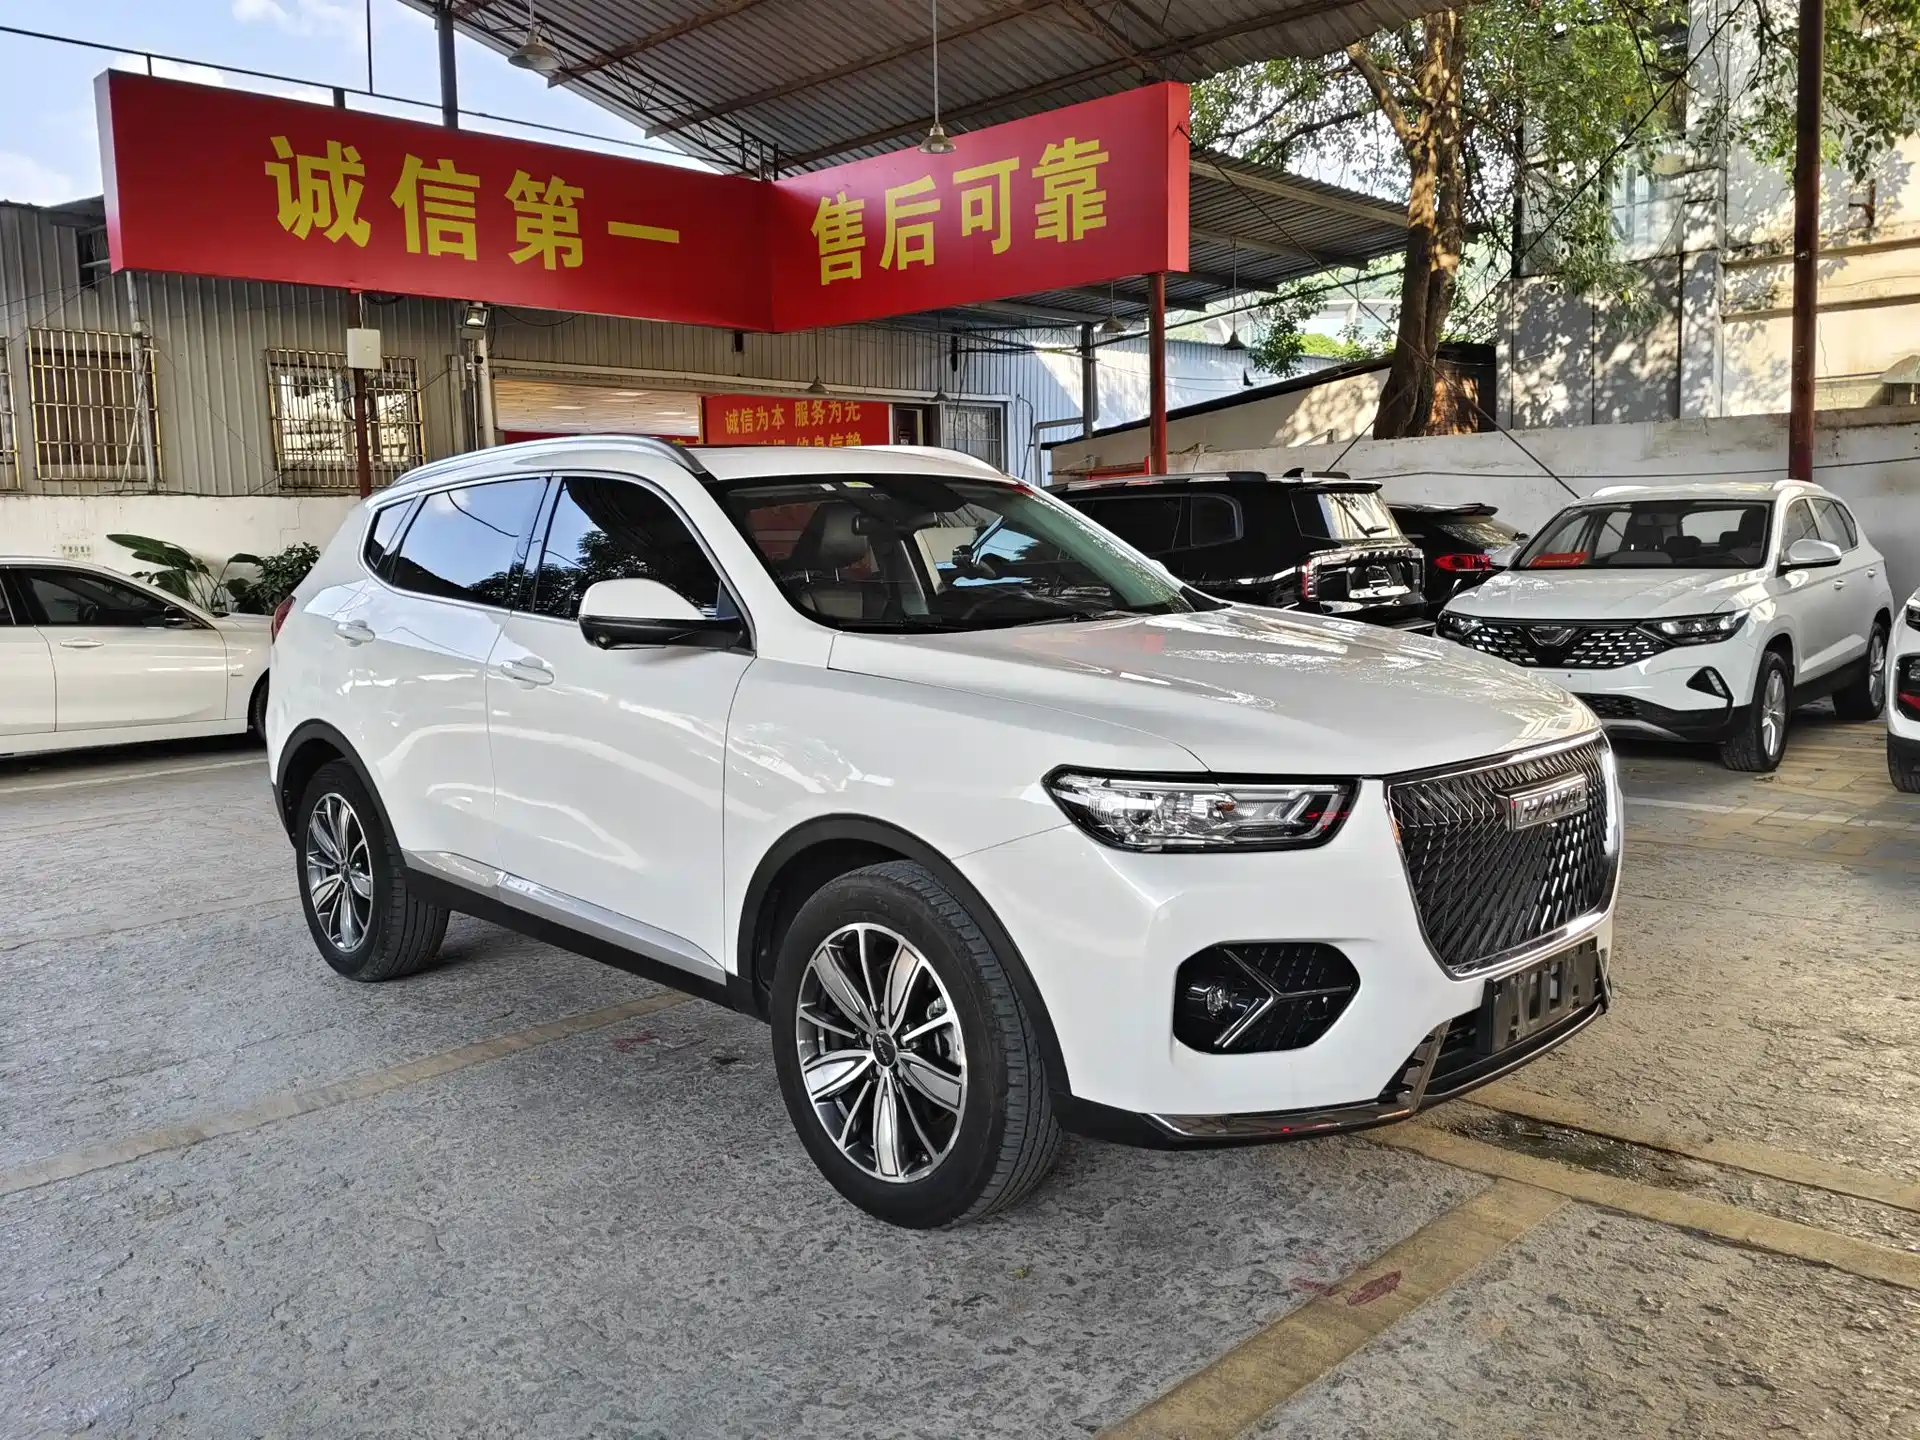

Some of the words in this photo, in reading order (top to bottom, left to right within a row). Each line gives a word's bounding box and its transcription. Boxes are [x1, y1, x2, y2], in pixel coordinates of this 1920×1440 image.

[264, 135, 680, 271] 诚信第一
[810, 136, 1109, 286] 售后可靠
[724, 403, 785, 435] 诚信为本
[794, 400, 862, 427] 服务为先
